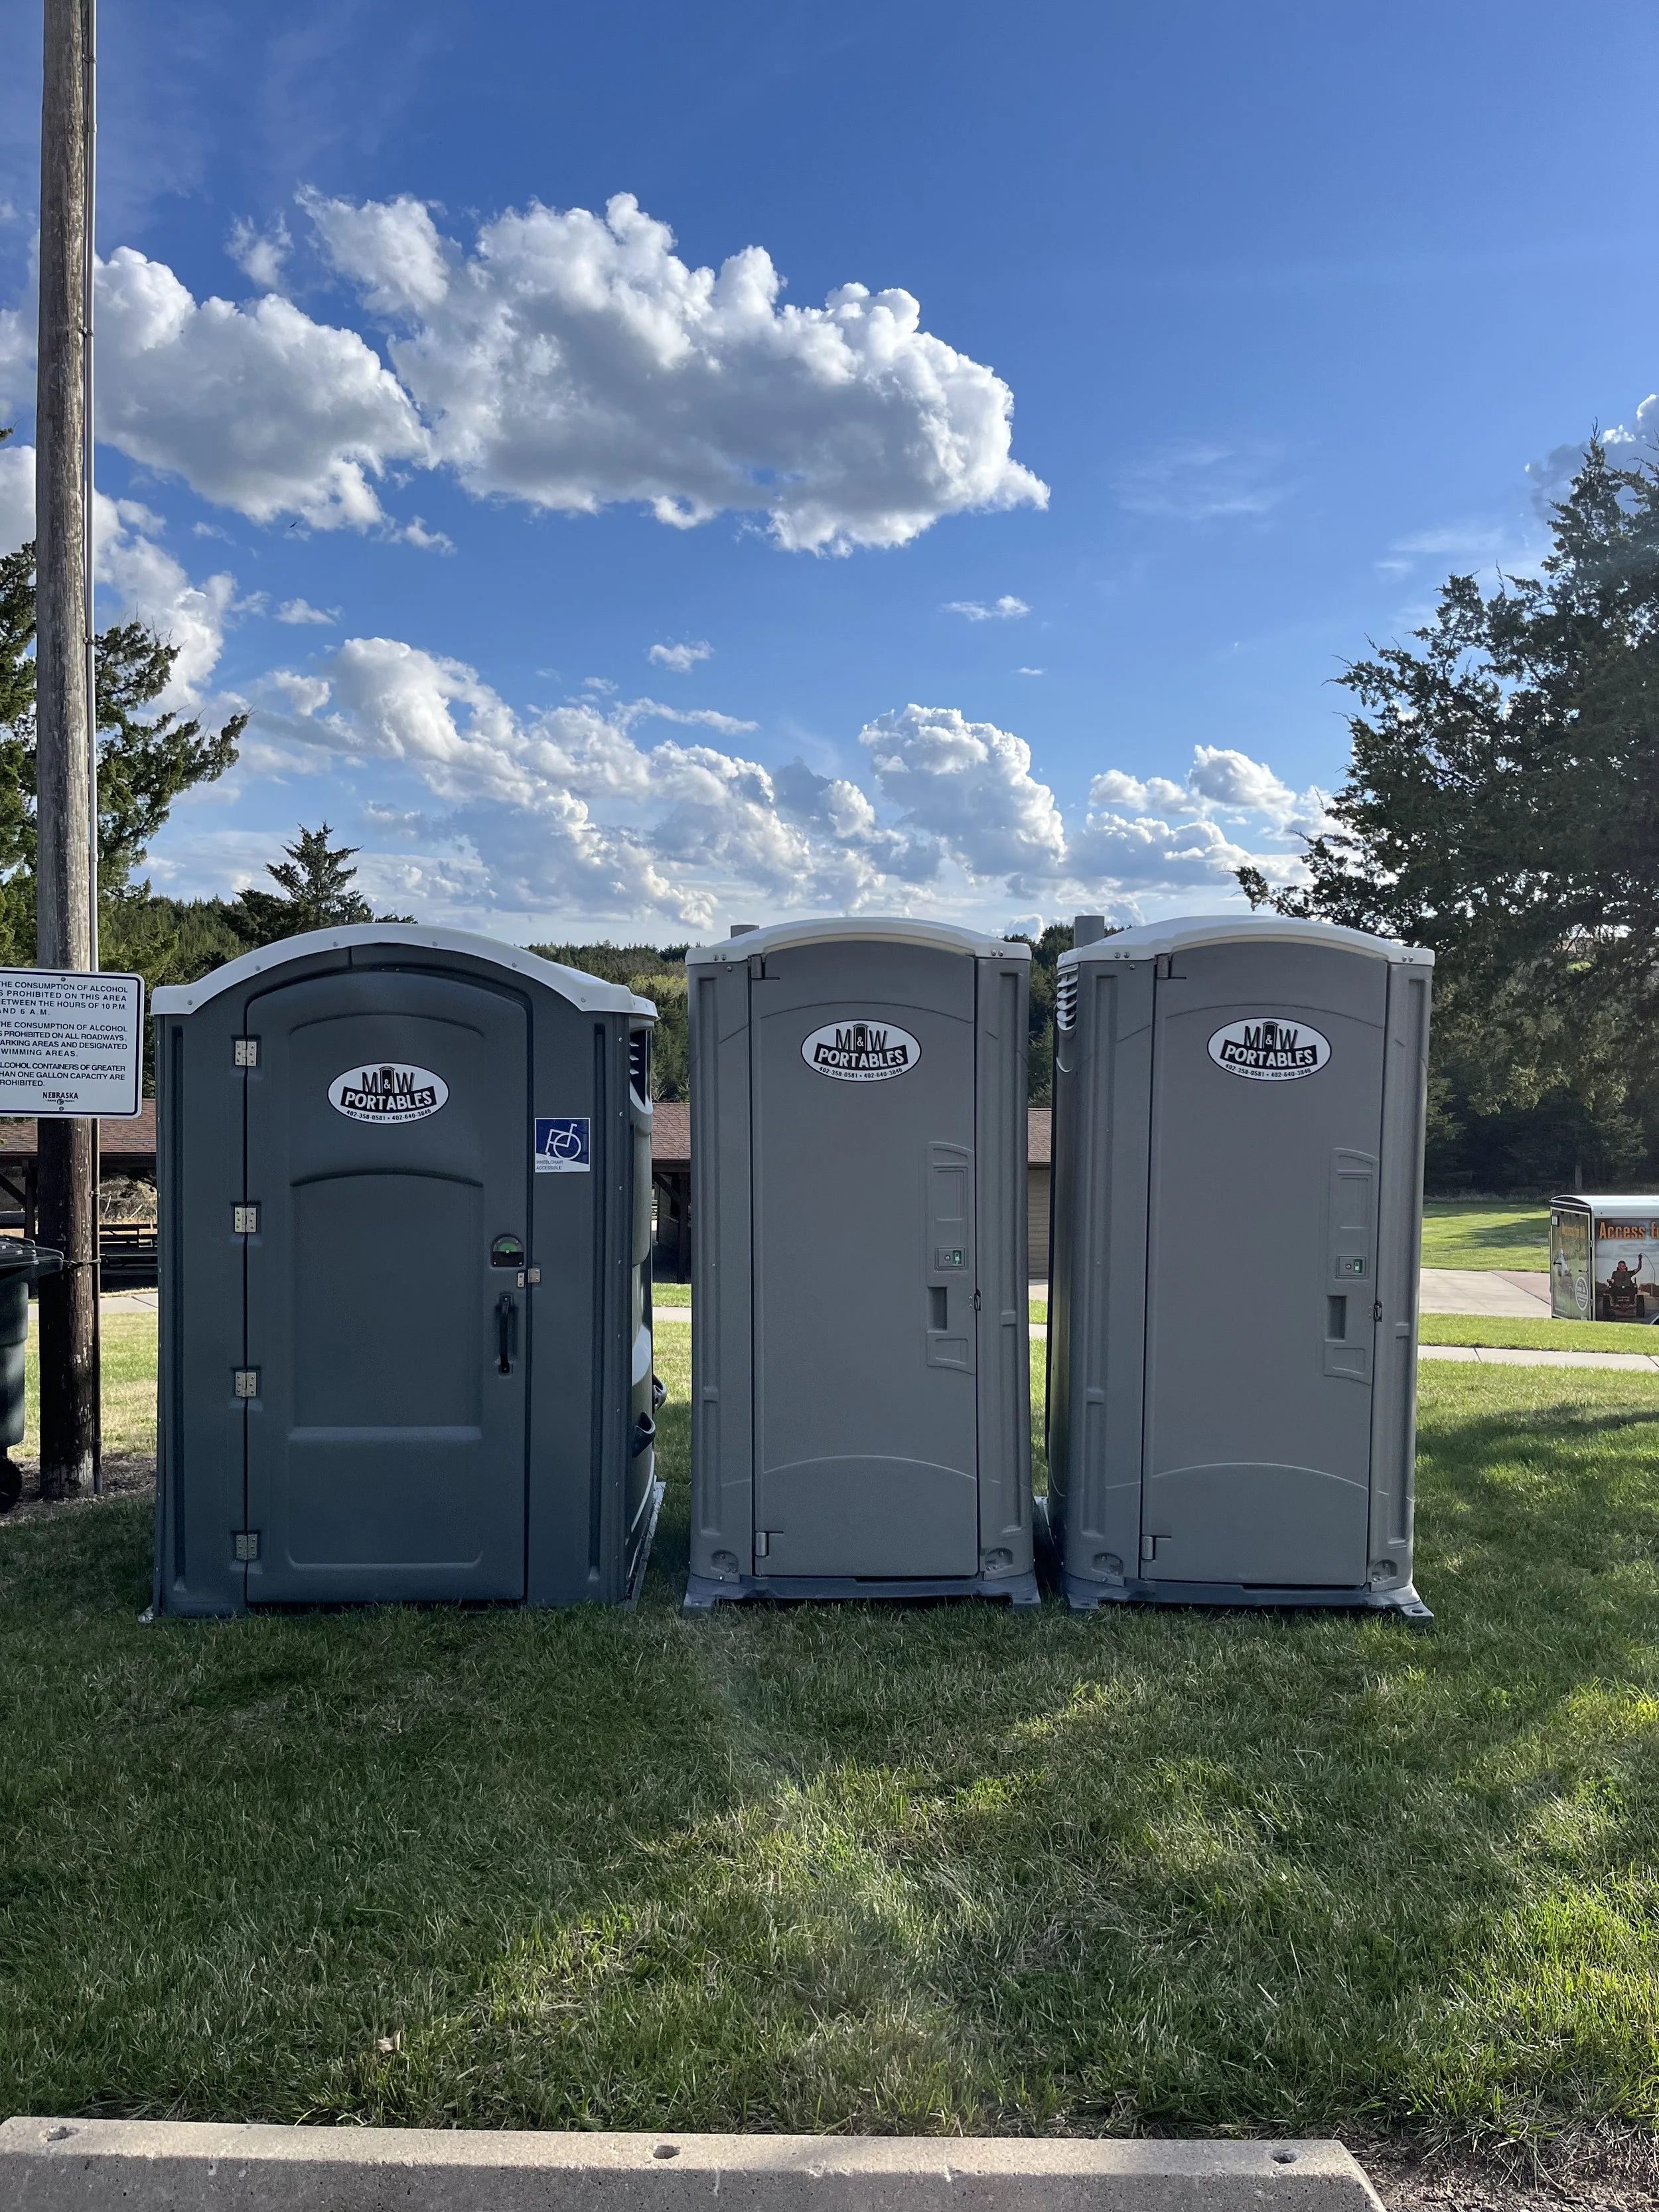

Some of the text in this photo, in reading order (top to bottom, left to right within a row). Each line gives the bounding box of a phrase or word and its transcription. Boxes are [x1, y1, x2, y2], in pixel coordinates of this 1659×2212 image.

[15, 982, 75, 990] CONSUMPTION
[818, 1048, 904, 1068] PORTABLES
[1224, 1045, 1314, 1067] PORTABLES
[819, 1067, 902, 1078] 402-358-0581 402-640-3846
[344, 1090, 433, 1110] PORTABLES
[346, 1108, 431, 1121] 402-358-0581 402-640-3846
[1599, 1221, 1646, 1239] Access
